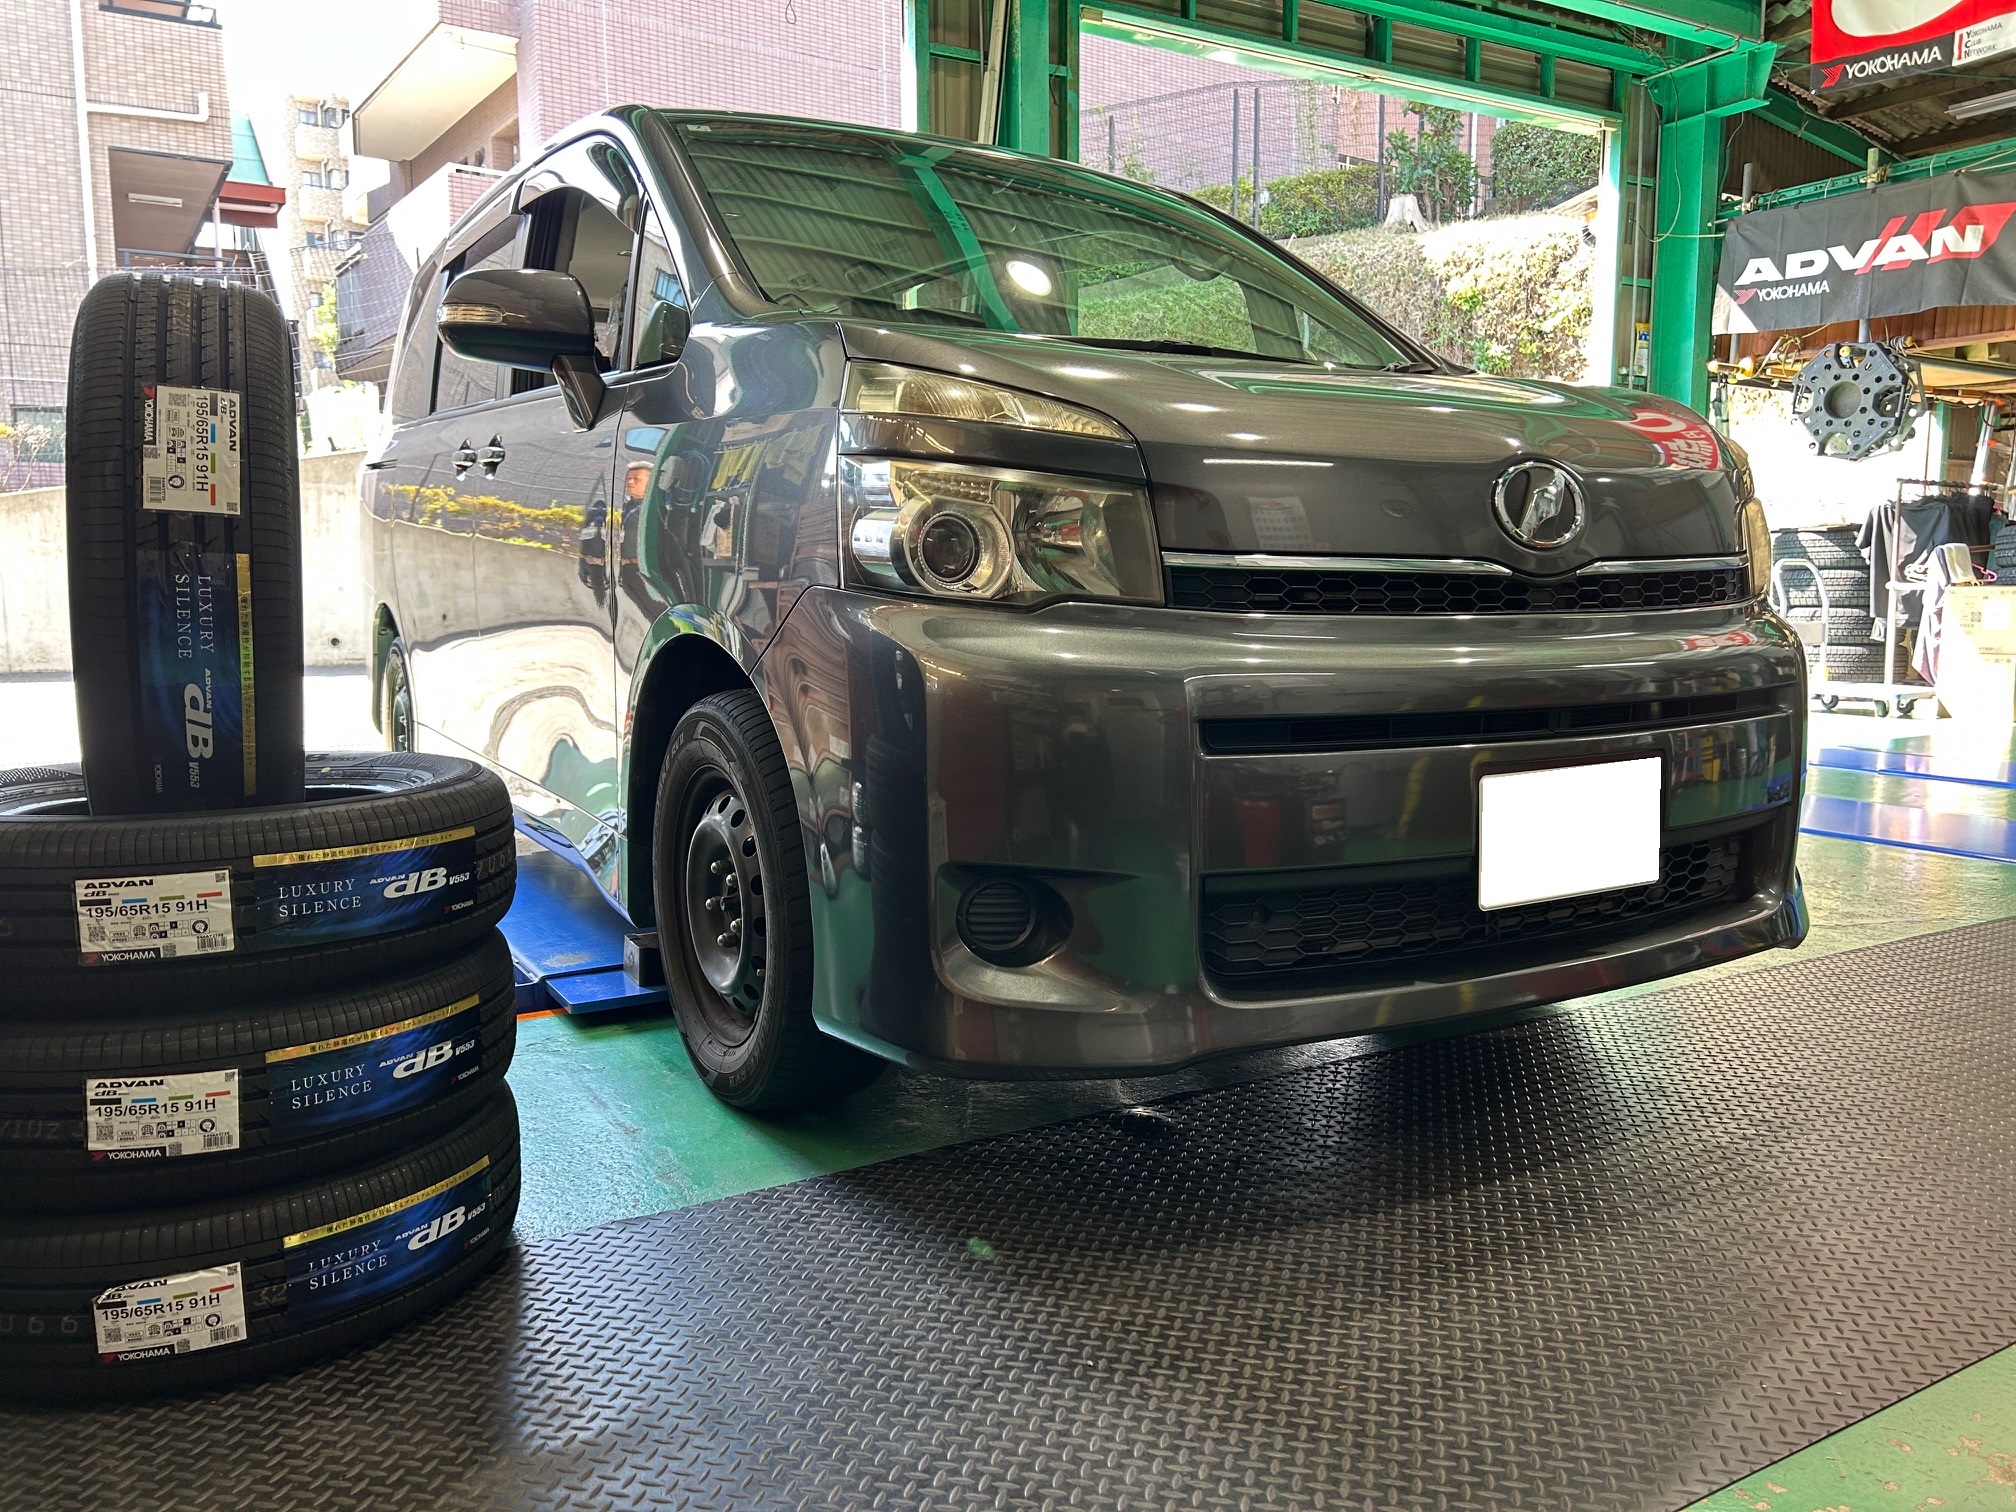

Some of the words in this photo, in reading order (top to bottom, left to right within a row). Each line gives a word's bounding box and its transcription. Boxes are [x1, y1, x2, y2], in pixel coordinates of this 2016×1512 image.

[1845, 45, 1942, 79] YOKOHAMA
[1964, 44, 1997, 59] NETWORK
[1734, 224, 1984, 286] ADVAN
[1757, 280, 1830, 302] YOKOHAMA
[144, 399, 154, 442] YOKOHAMA
[196, 395, 209, 461] 195/65R15
[229, 398, 237, 452] ADVAN
[196, 464, 209, 492] 91H
[175, 573, 192, 659] SILENCE
[197, 575, 214, 653] LUXURY
[204, 668, 212, 709] ADVAN
[184, 683, 214, 759] dB
[154, 763, 163, 793] YOKOHAMA
[188, 761, 200, 789] V553
[84, 879, 154, 890] ADVAN
[278, 878, 355, 899] LUXURY
[369, 874, 406, 885] ADVAN
[383, 866, 447, 899] dB
[449, 872, 470, 886] V553
[86, 902, 171, 918] 195/65R15
[175, 899, 208, 913] 91H
[279, 896, 362, 918] SILENCE
[451, 899, 474, 912] YOKOHAMA
[101, 950, 156, 962] YOKOHAMA
[378, 1052, 414, 1068] ADVAN
[392, 1040, 453, 1079] dB
[455, 1040, 475, 1056] V553
[457, 1065, 480, 1081] YOKOHAMA
[95, 1079, 164, 1089] ADVAN
[291, 1063, 366, 1092] LUXURY
[94, 1102, 180, 1118] 195/65R15
[184, 1098, 216, 1112] 91H
[292, 1080, 372, 1110] SILENCE
[107, 1149, 162, 1160] YOKOHAMA
[394, 1223, 428, 1242] ADVAN
[407, 1205, 466, 1251] dB
[467, 1202, 486, 1221] V553
[469, 1227, 490, 1245] YOKOHAMA
[308, 1239, 382, 1272] LUXURY
[310, 1254, 388, 1291] SILENCE
[101, 1300, 184, 1321] 195/65R15
[189, 1292, 220, 1309] 91H
[117, 1347, 171, 1362] YOKOHAMA
